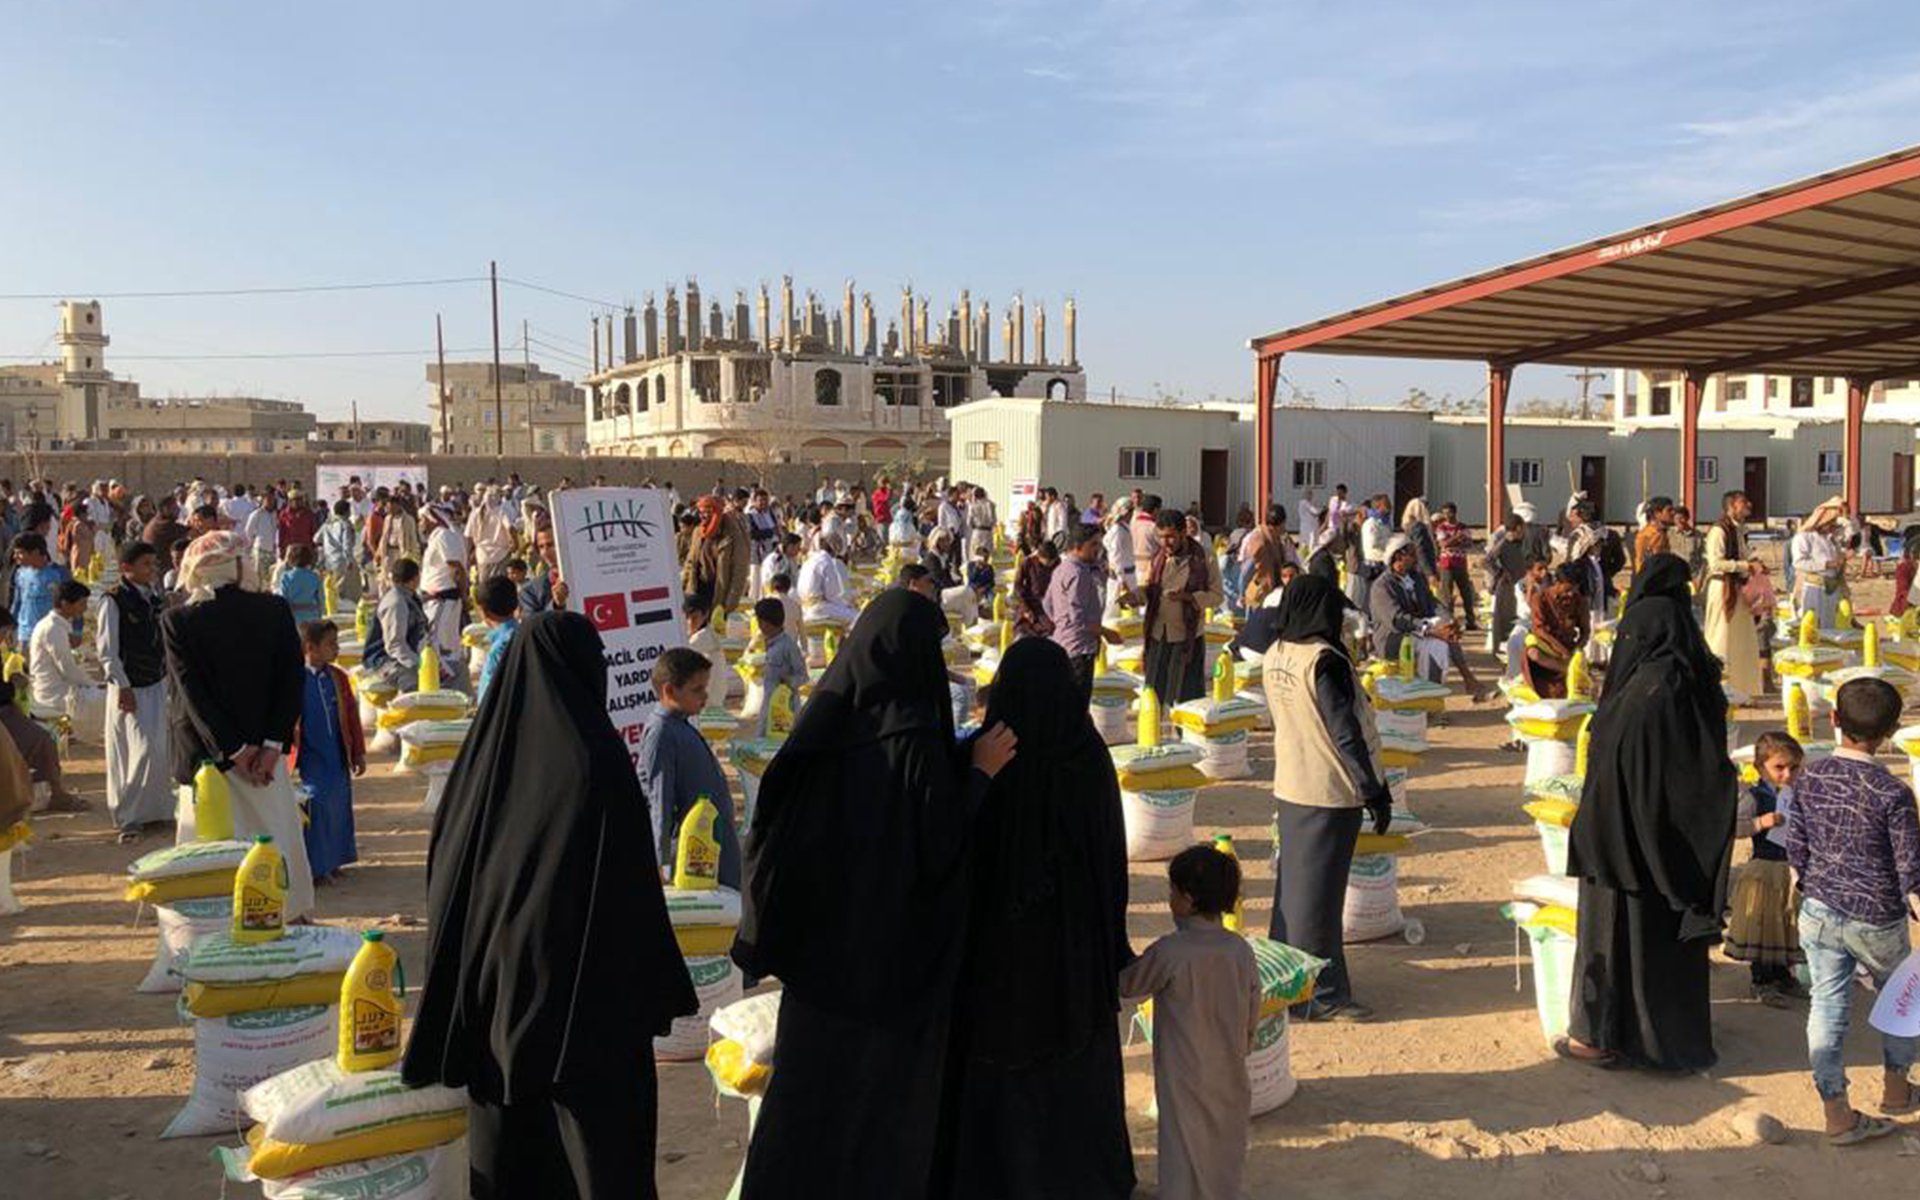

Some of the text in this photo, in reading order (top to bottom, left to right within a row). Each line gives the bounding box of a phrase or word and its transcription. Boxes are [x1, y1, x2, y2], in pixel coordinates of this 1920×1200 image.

[584, 499, 653, 542] HAK
[636, 644, 665, 661] GIDA
[608, 689, 660, 712] ALIŞMA
